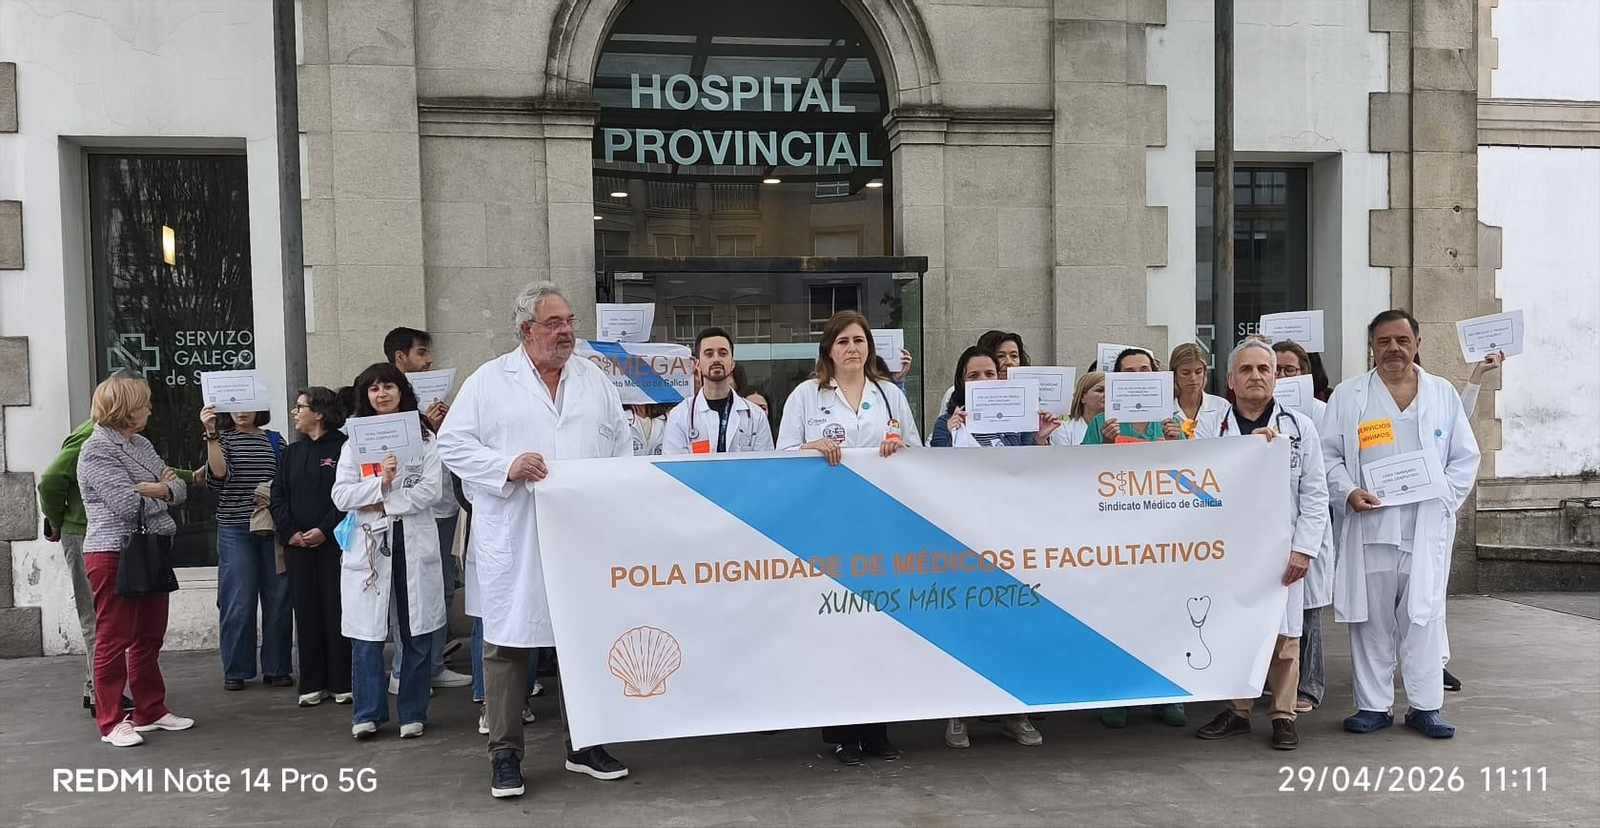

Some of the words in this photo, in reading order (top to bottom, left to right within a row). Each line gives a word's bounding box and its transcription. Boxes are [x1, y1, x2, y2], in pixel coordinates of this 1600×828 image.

[630, 73, 856, 113] HOSPITAL
[604, 128, 883, 167] PROVINCIAL
[175, 330, 253, 346] SERVIZO
[174, 350, 253, 366] GALEGO
[165, 369, 187, 386] de
[664, 378, 689, 387] Galicia
[1098, 501, 1141, 512] Sindicato
[1143, 499, 1176, 510] Médico
[1178, 499, 1190, 509] de
[1192, 498, 1223, 508] Galicia
[610, 563, 687, 588] POLA
[694, 553, 843, 585] DIGNIDADE
[851, 553, 885, 577] DE
[893, 547, 1015, 574] MÉDICOS
[1022, 548, 1038, 570] E
[1044, 539, 1225, 569] FACULTATIVOS
[818, 588, 901, 615] XUNTOS
[908, 582, 957, 612] MÁIS
[965, 582, 1042, 610] FORTES
